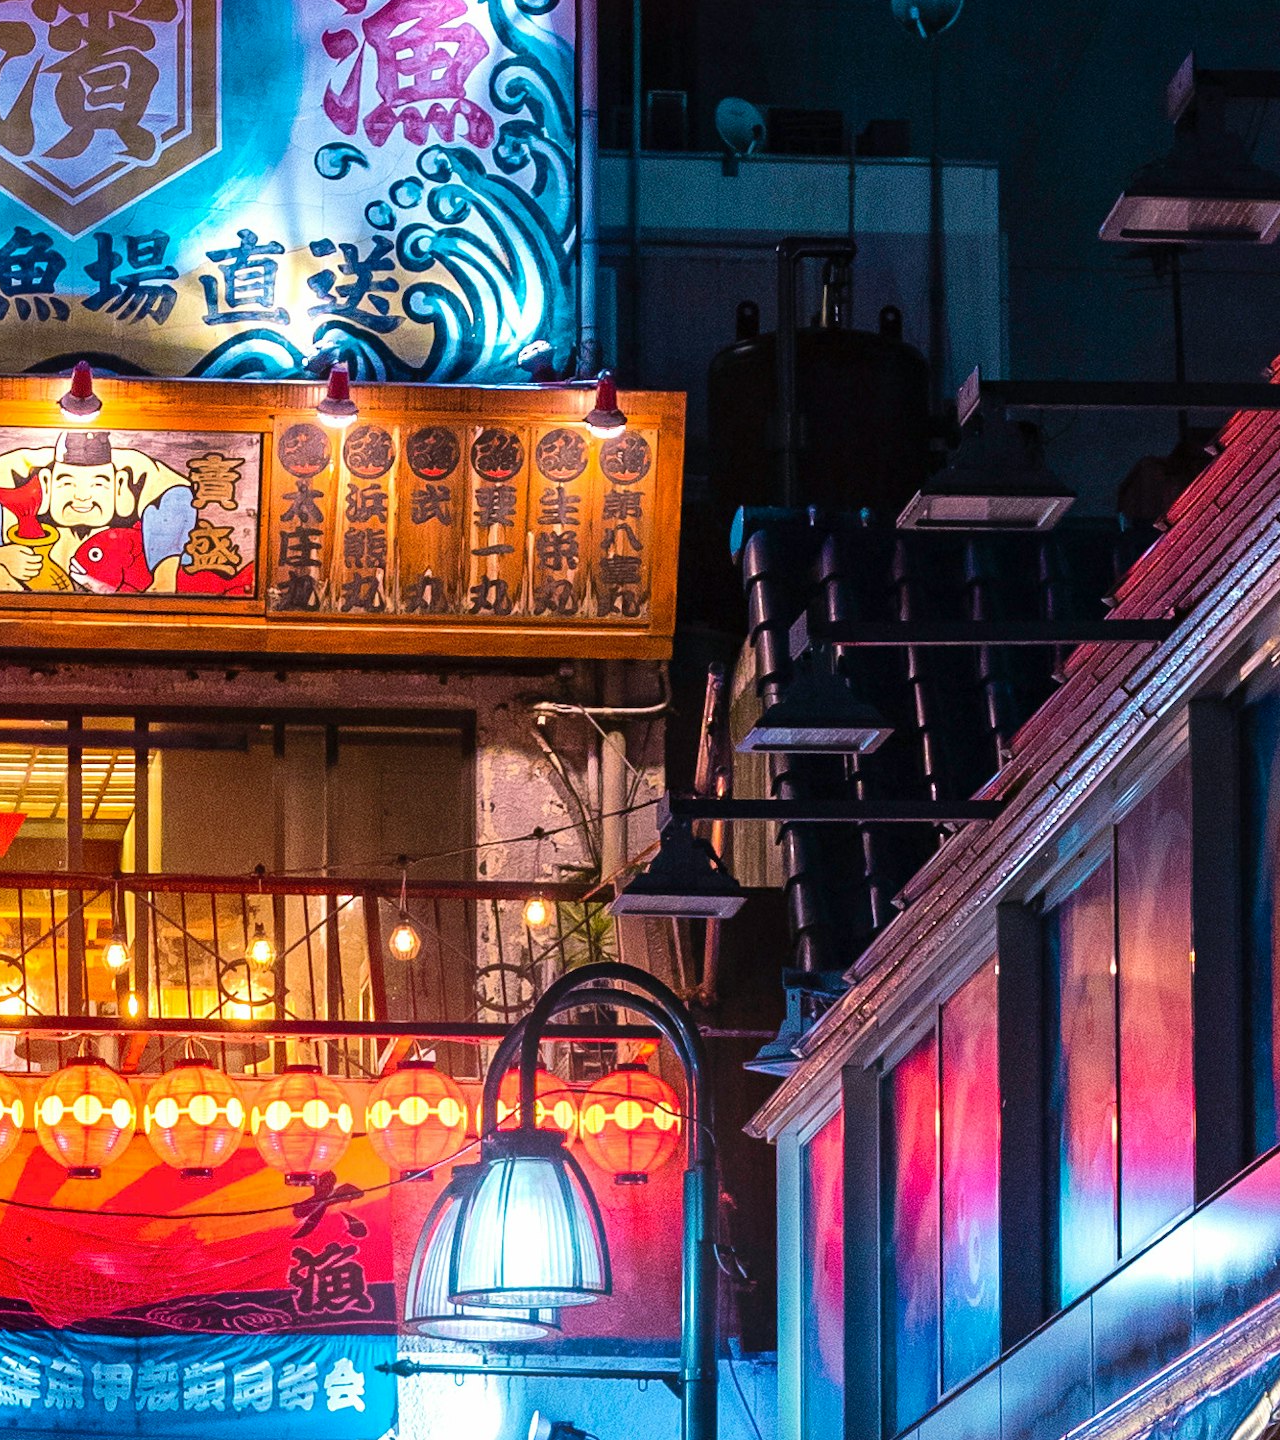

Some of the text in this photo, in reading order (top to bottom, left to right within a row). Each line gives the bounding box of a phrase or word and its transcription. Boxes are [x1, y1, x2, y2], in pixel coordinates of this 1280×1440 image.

[184, 520, 243, 576] 盛
[341, 483, 389, 613] 浜熊丸
[405, 484, 452, 613] 武丸
[290, 1172, 375, 1315] 大漁
